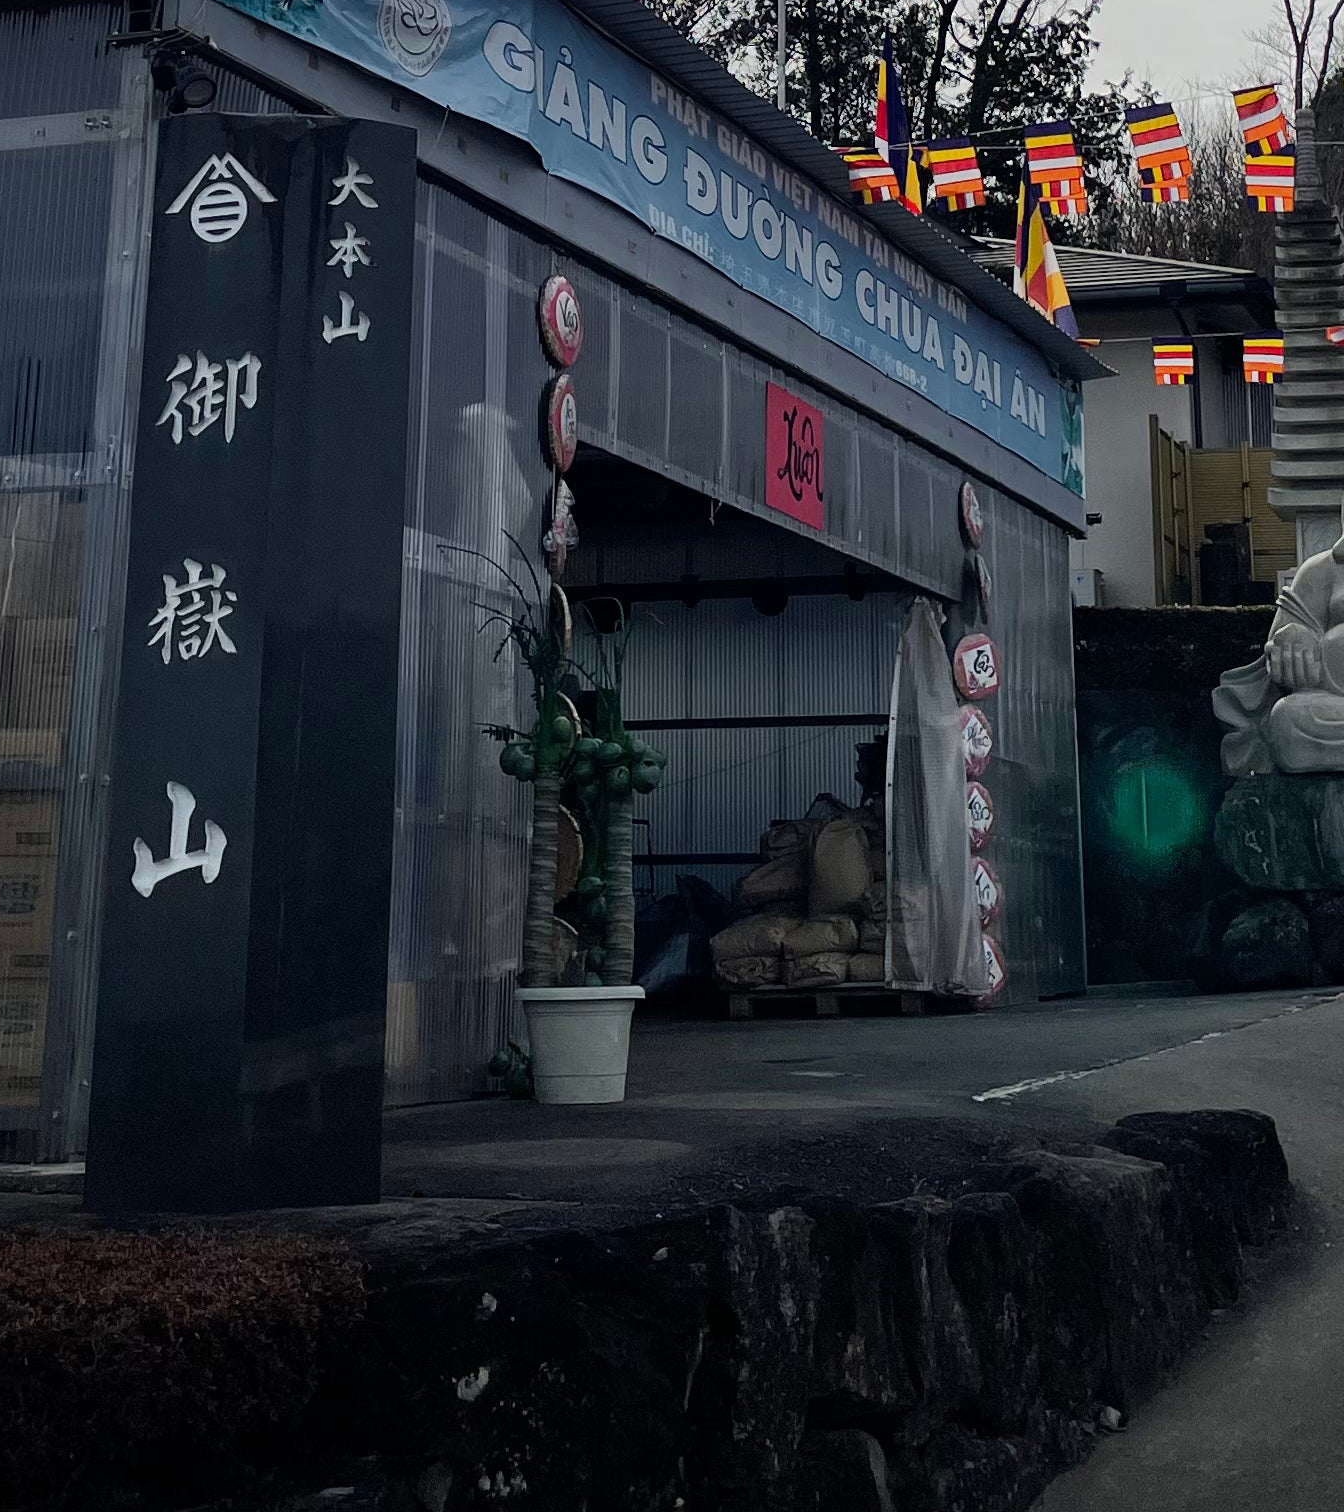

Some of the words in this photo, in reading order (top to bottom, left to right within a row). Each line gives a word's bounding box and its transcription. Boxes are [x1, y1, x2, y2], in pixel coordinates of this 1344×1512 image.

[322, 155, 379, 346] 大本山
[482, 19, 668, 185] GIẢNG
[683, 146, 844, 302] ĐƯỜNG
[855, 267, 945, 373] CHÙA
[952, 332, 1002, 410] ĐẠI
[1009, 366, 1046, 438] ÂN
[717, 124, 767, 179] GIÁO
[772, 162, 813, 213] VIỆT
[817, 205, 859, 249] NAM
[863, 231, 889, 269] TẠI
[131, 347, 264, 898] 御嶽山
